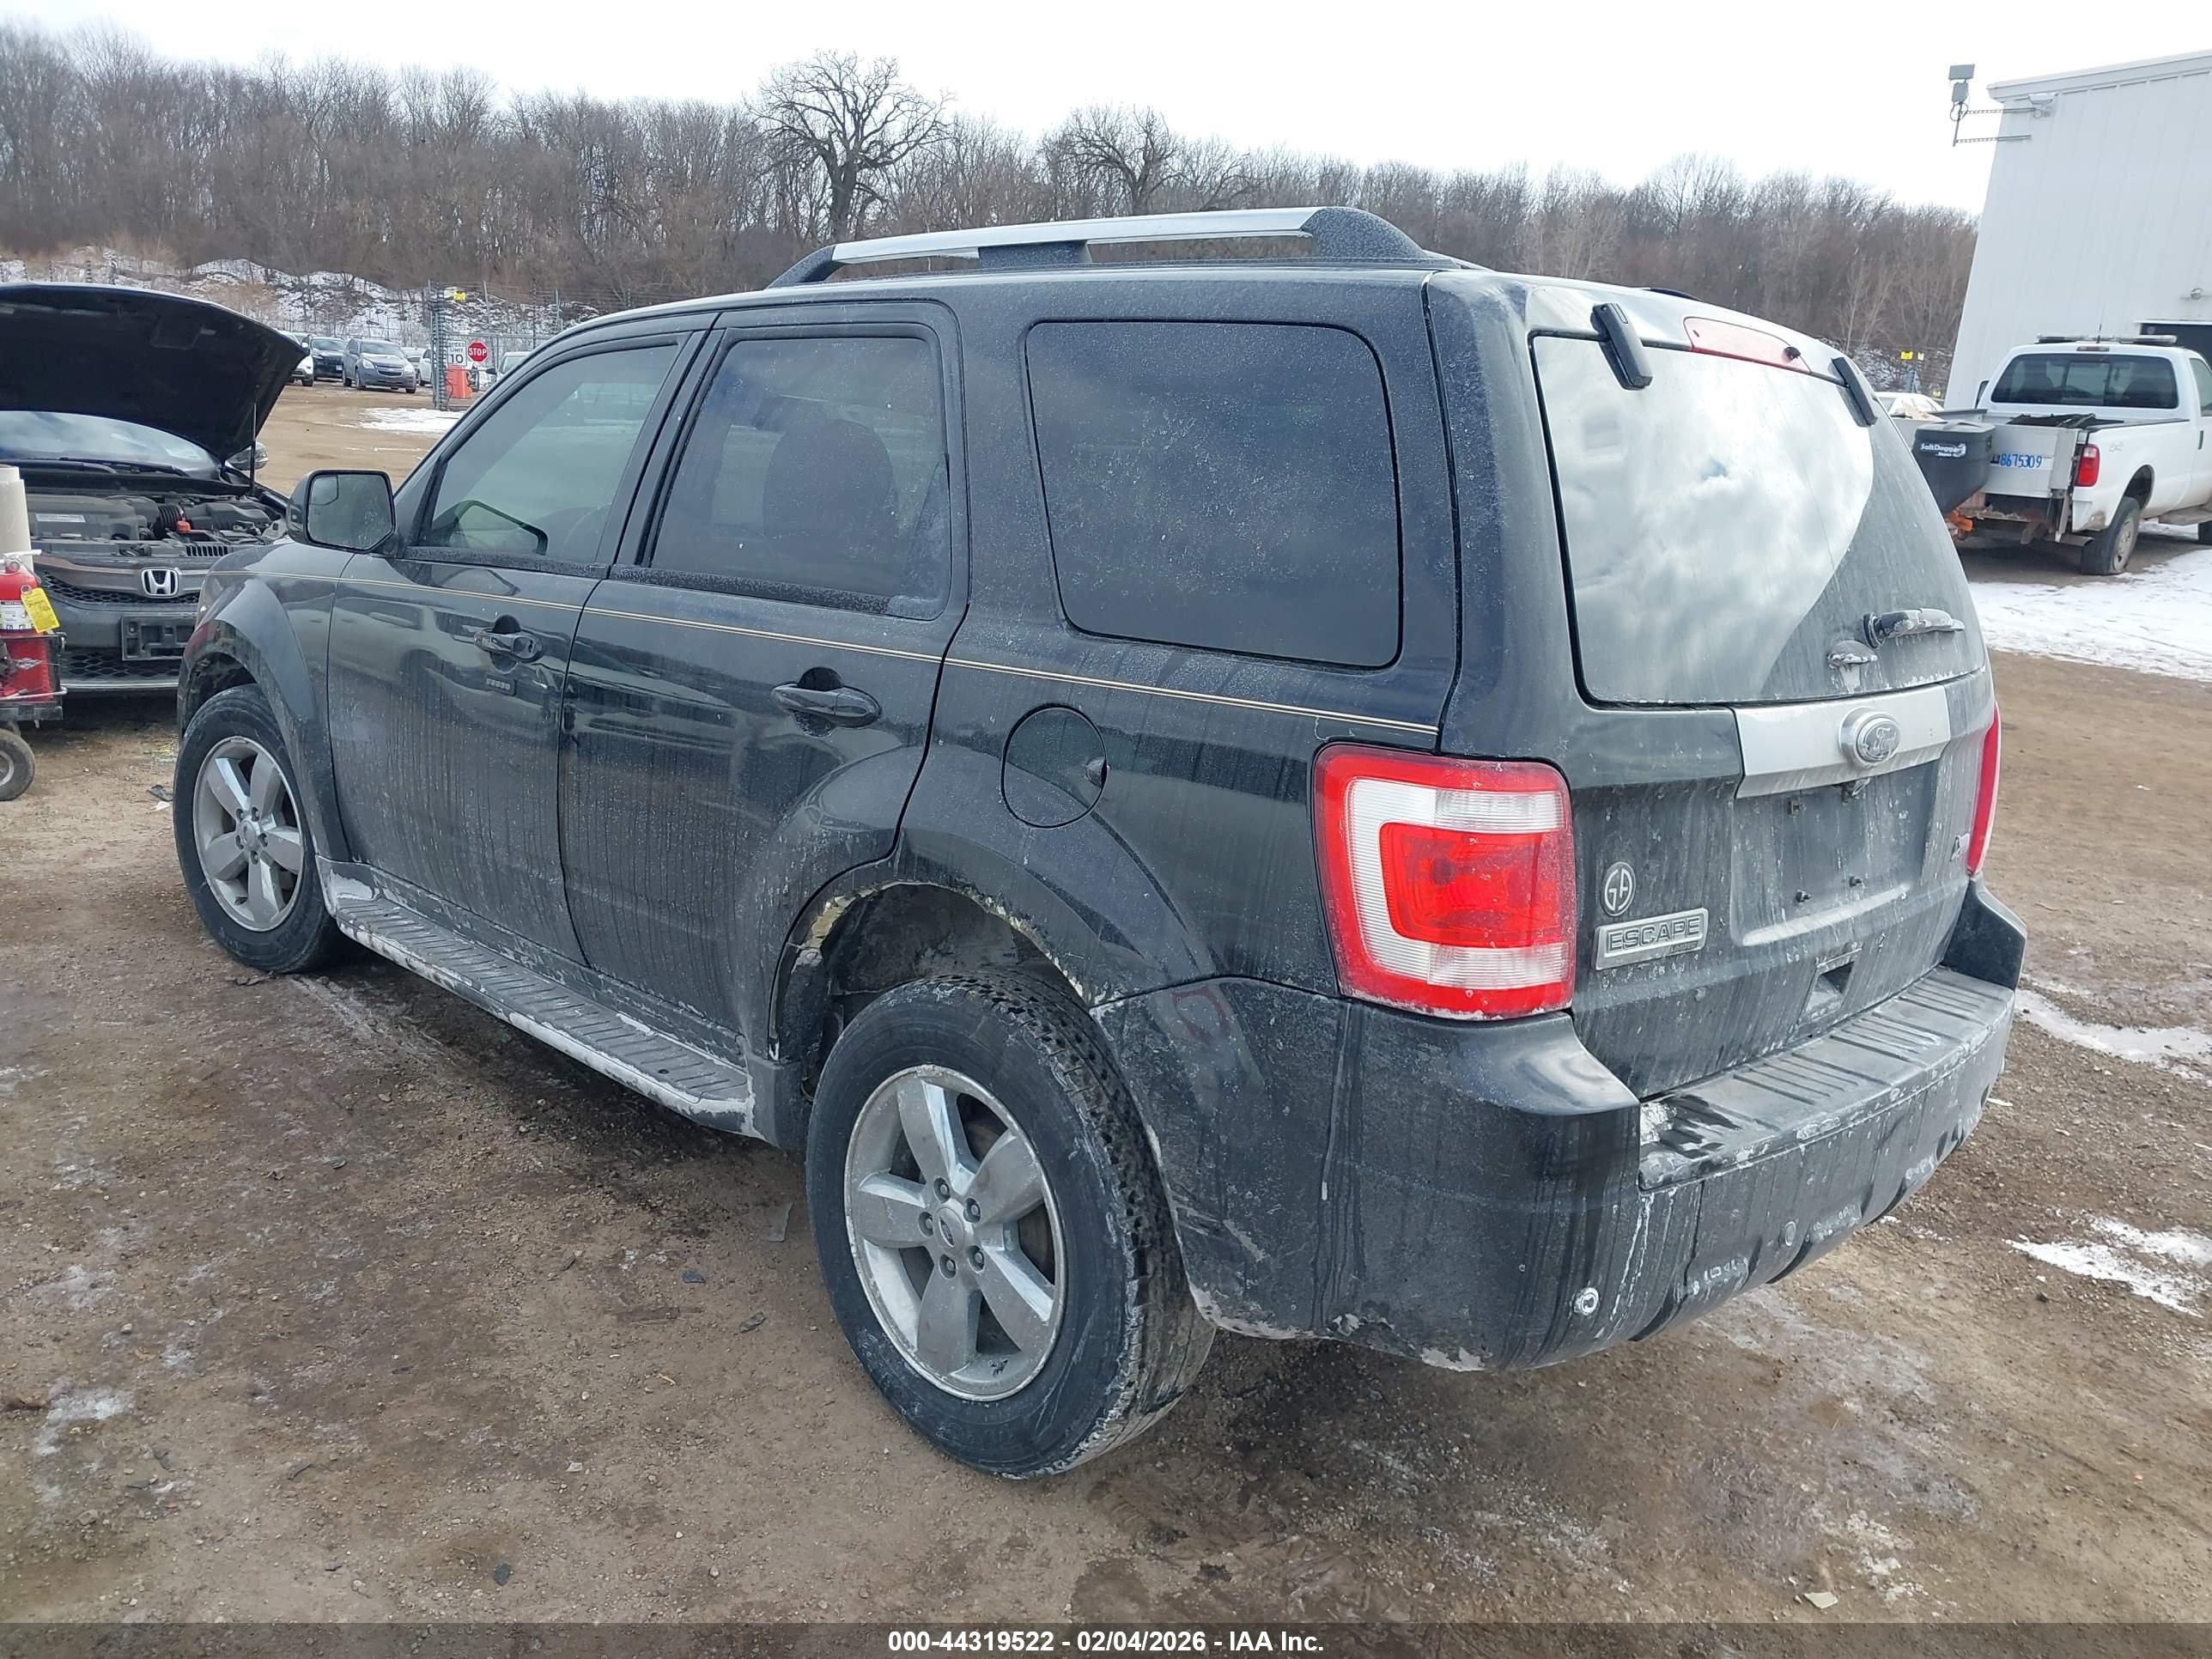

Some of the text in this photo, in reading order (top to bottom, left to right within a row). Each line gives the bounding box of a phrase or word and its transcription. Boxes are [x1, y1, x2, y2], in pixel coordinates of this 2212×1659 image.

[468, 347, 487, 356] STOP
[450, 354, 464, 363] 10
[2000, 453, 2042, 468] 8675309
[1607, 915, 1701, 952] ESCAPE
